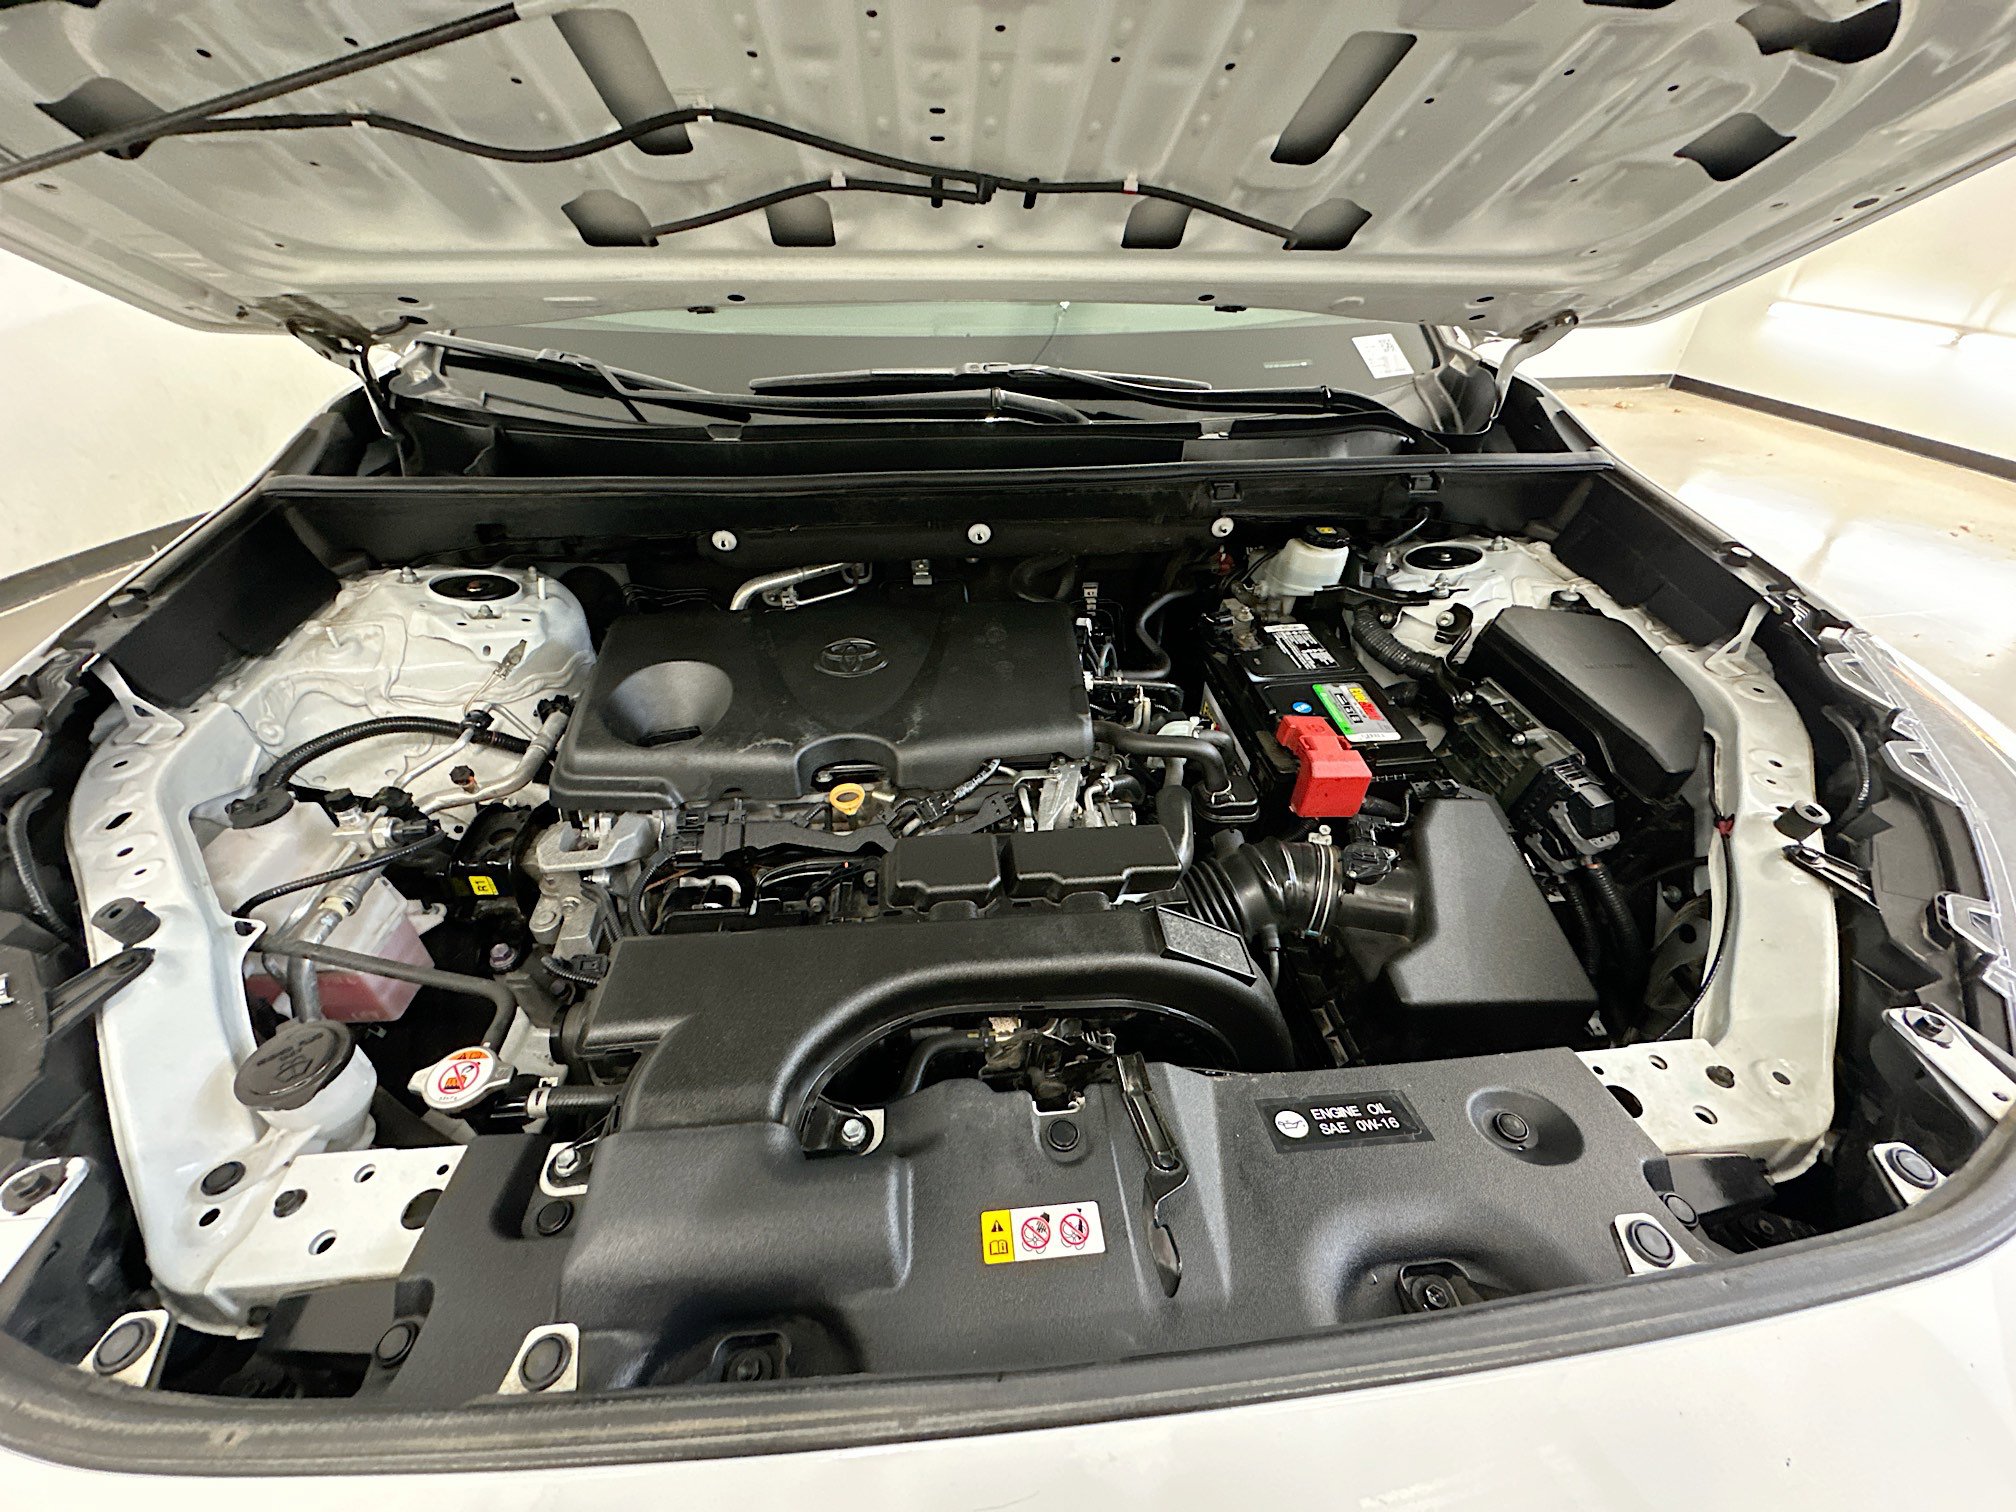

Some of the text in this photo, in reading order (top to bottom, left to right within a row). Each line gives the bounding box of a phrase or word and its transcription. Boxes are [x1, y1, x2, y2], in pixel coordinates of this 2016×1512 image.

[1310, 1102, 1392, 1121] ENGINE OIL
[1319, 1117, 1400, 1135] SAE 0W-16
